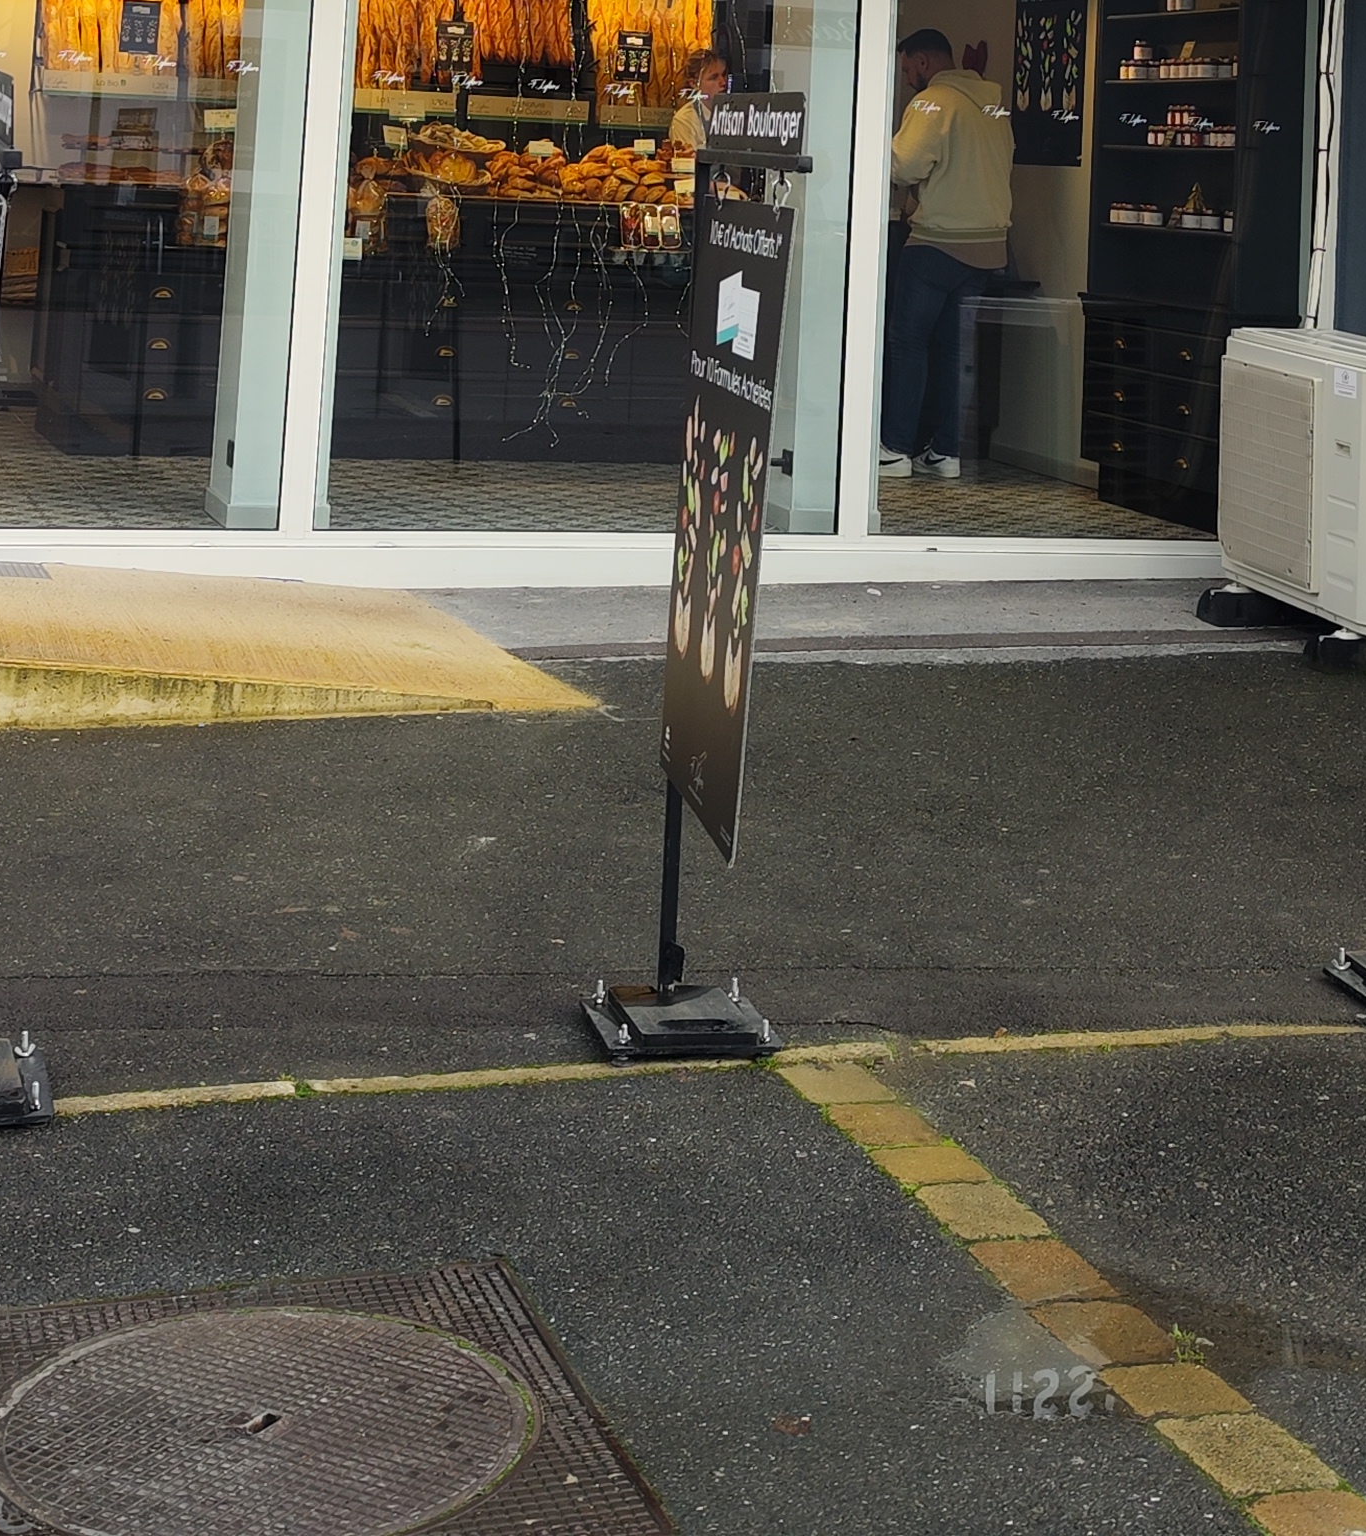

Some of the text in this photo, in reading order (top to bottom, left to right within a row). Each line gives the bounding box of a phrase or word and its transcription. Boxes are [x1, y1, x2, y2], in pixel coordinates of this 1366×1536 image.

[709, 103, 745, 136] Artisan
[747, 102, 802, 147] Boulanger
[690, 350, 706, 378] Pour
